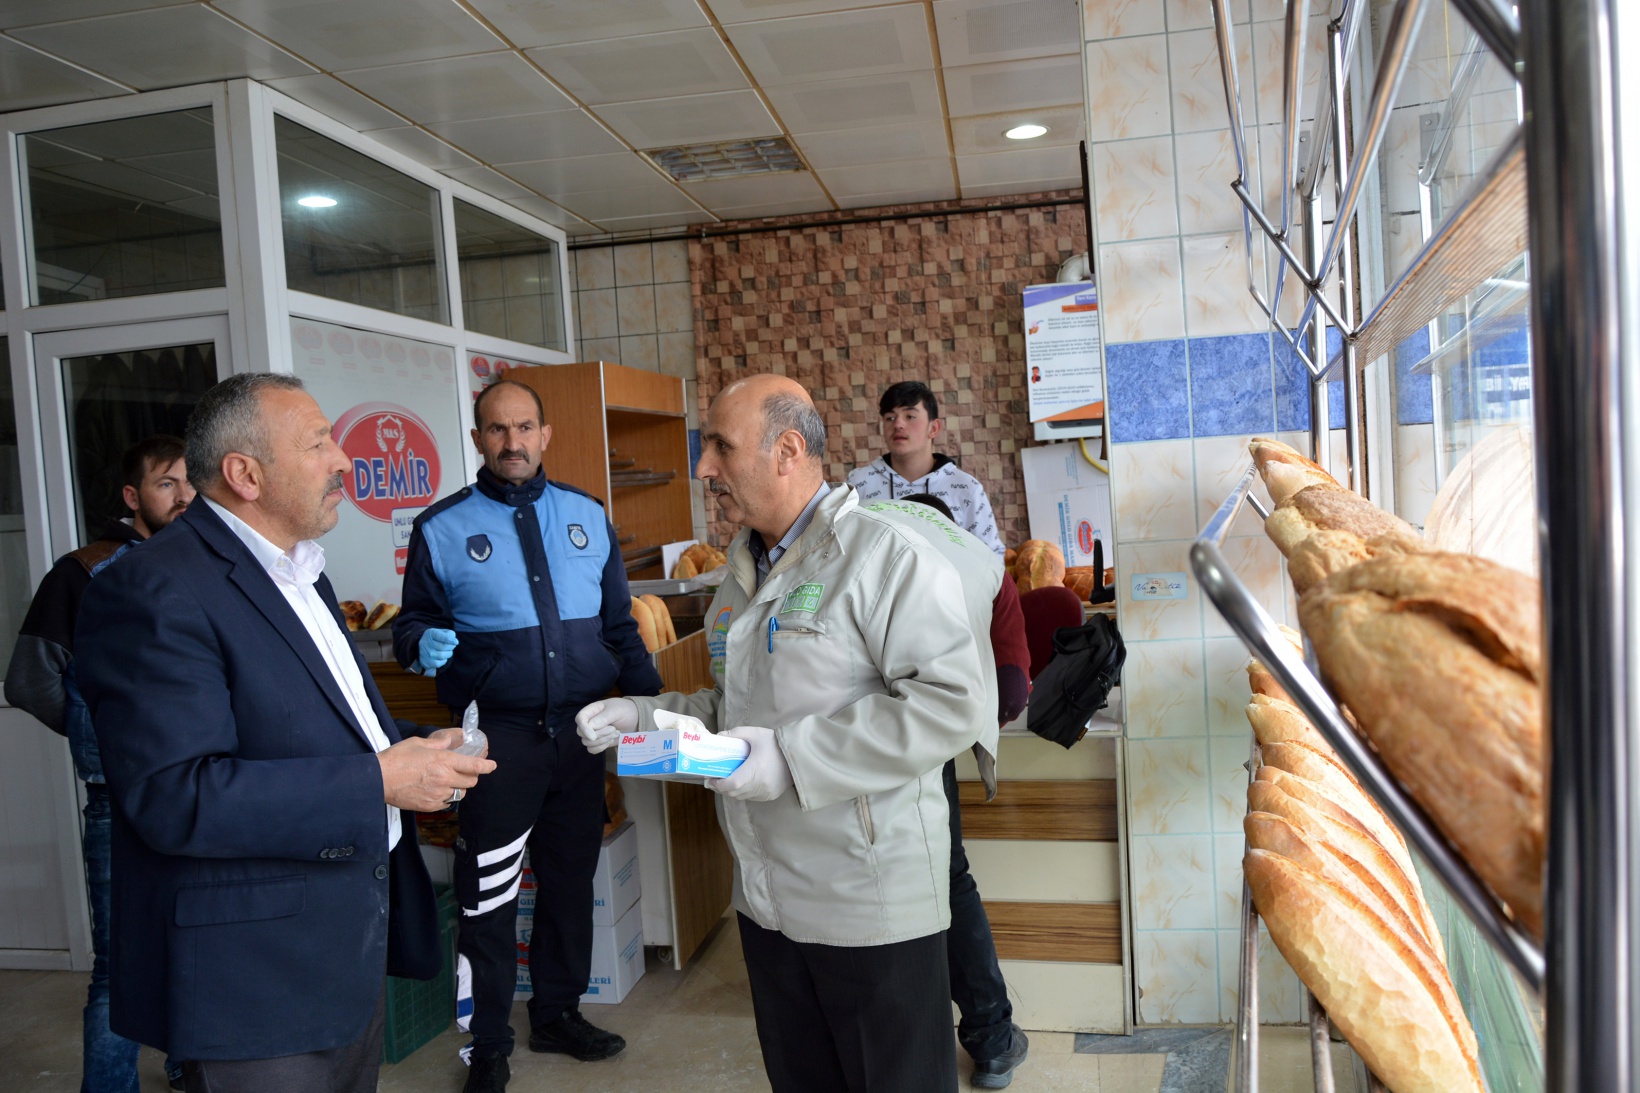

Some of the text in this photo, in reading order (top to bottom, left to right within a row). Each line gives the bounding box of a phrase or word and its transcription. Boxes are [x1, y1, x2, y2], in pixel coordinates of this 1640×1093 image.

[353, 448, 433, 502] DEMİR
[622, 734, 646, 745] Beybi
[683, 731, 701, 742] Beybi
[663, 740, 672, 750] M
